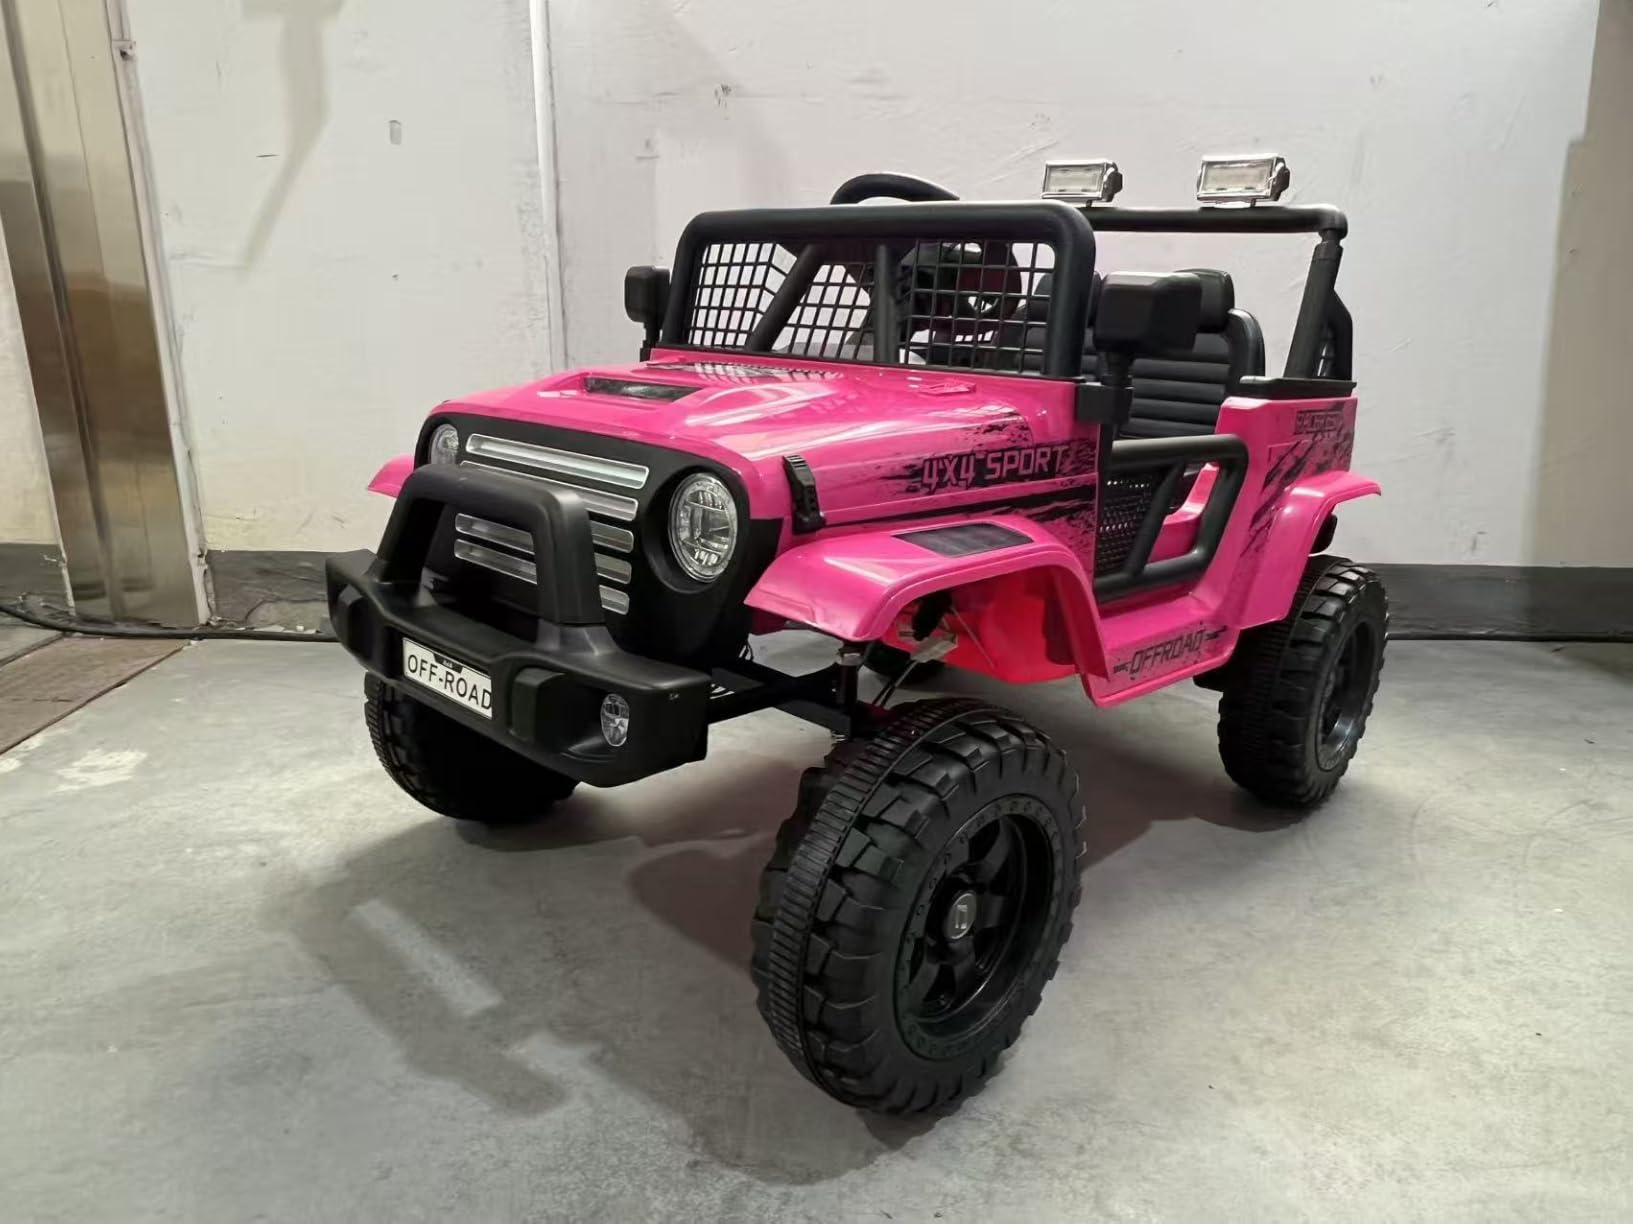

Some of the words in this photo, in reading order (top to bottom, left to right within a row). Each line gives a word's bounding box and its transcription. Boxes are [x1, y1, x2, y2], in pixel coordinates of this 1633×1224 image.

[984, 445, 1069, 481] SPORT
[1129, 628, 1206, 675] OFFROAD
[407, 654, 492, 710] OFF-ROAD
